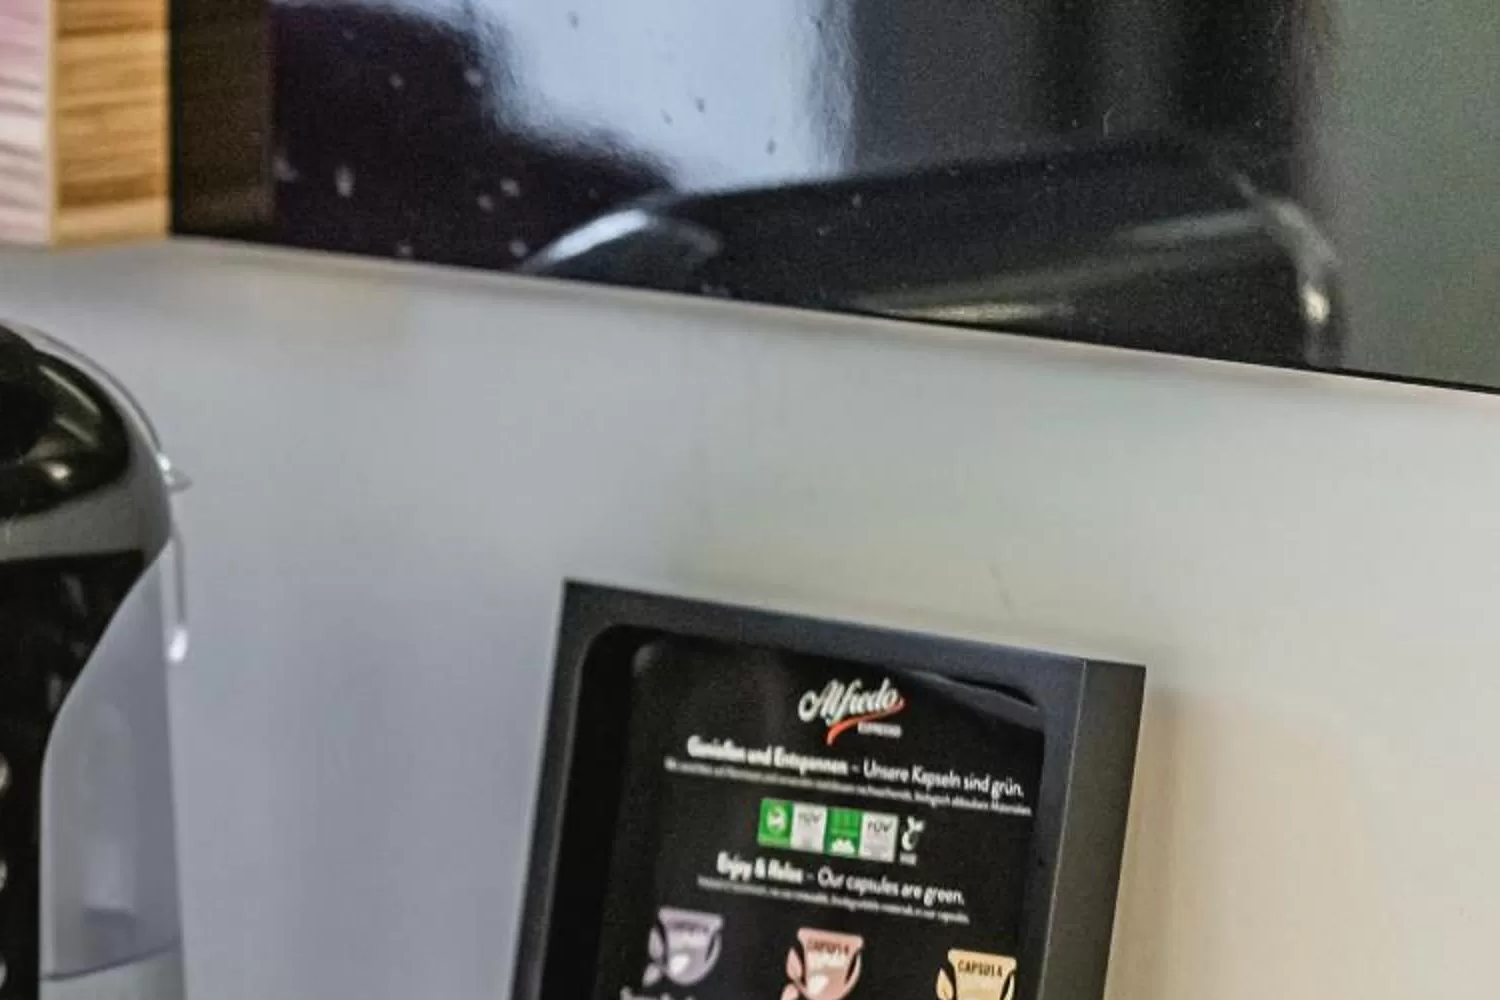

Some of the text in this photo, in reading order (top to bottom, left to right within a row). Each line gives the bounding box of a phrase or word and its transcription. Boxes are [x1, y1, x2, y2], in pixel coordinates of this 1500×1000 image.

[798, 678, 902, 727] Alfredo
[863, 758, 909, 783] Unsere
[911, 764, 961, 792] Kapseln
[963, 772, 990, 794] sind
[991, 776, 1024, 802] grün.
[817, 865, 845, 889] Our
[845, 875, 899, 897] capsules
[901, 883, 922, 899] are
[923, 886, 965, 907] green.
